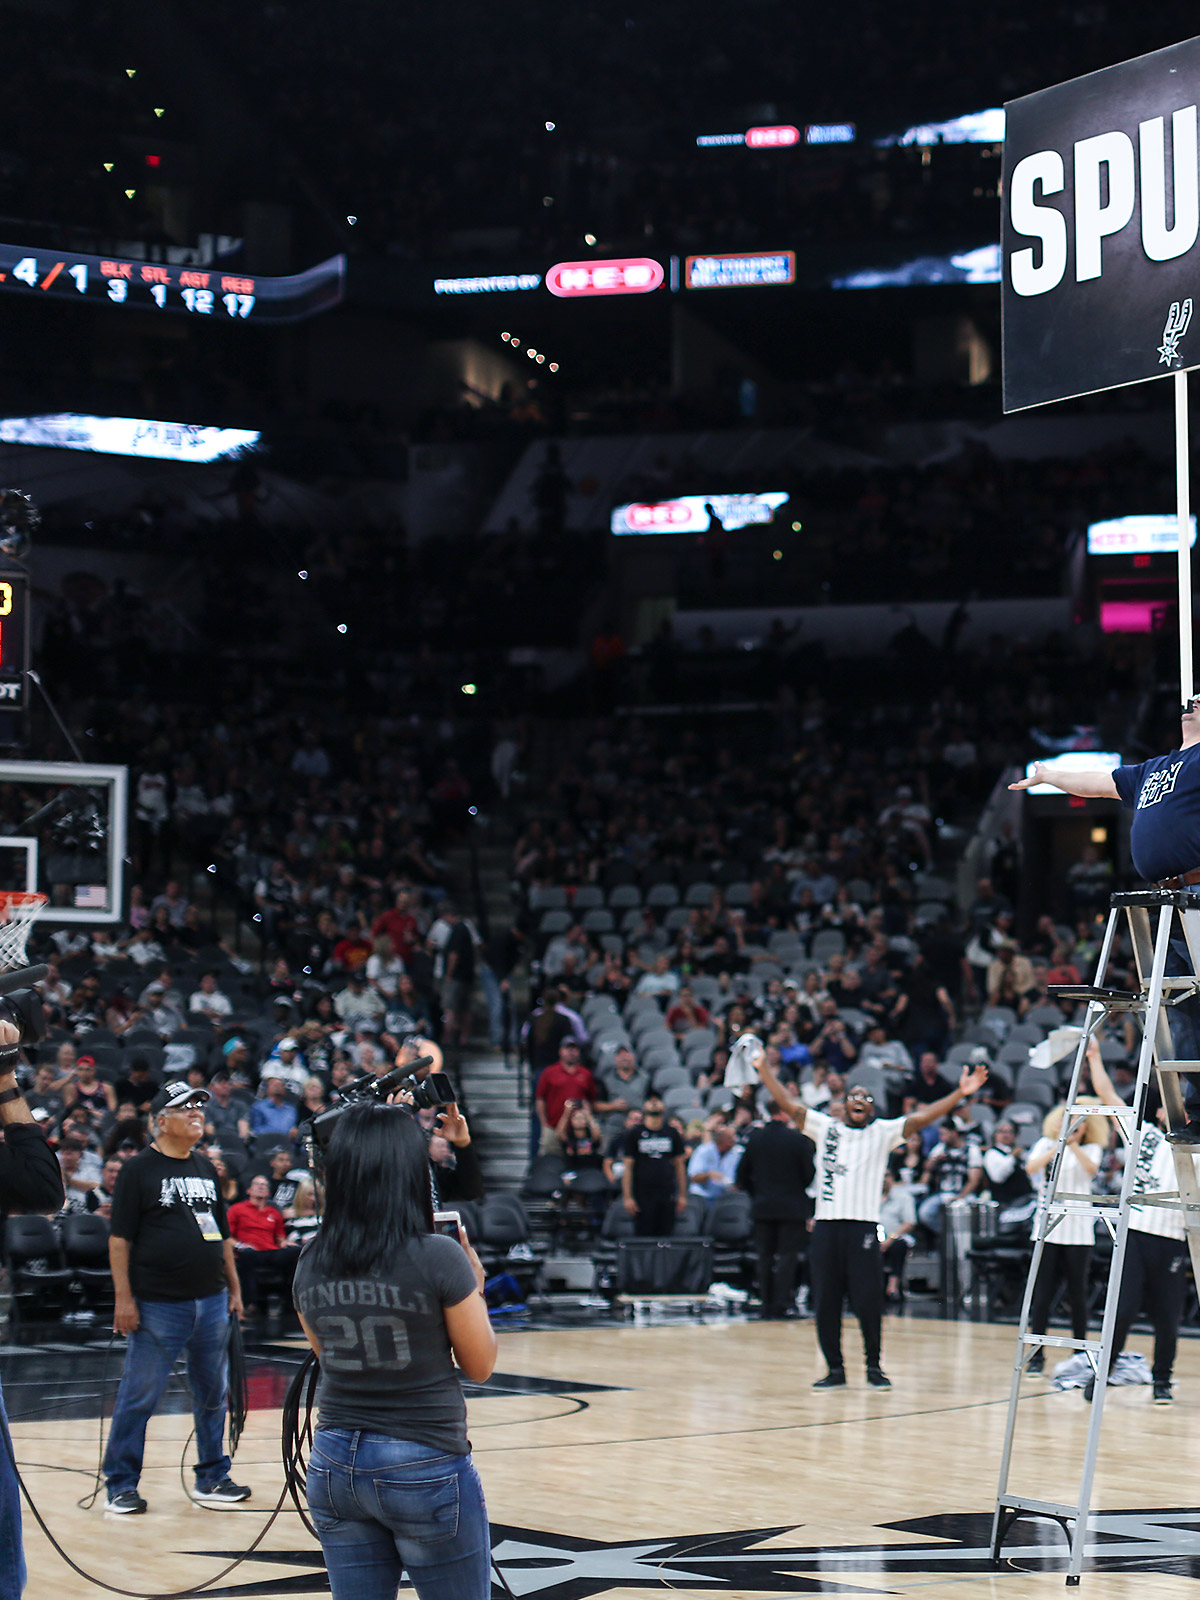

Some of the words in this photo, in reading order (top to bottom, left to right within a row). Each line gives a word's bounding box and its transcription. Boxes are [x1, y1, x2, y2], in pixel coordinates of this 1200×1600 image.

[100, 260, 132, 280] BLK
[140, 265, 171, 285] STL
[179, 271, 211, 289] AST
[221, 276, 255, 294] REB
[107, 278, 128, 303] 3
[150, 284, 167, 309] 1
[180, 288, 215, 314] 12
[222, 293, 255, 319] 17
[299, 1280, 432, 1315] GINOBILI
[315, 1316, 412, 1370] 20
